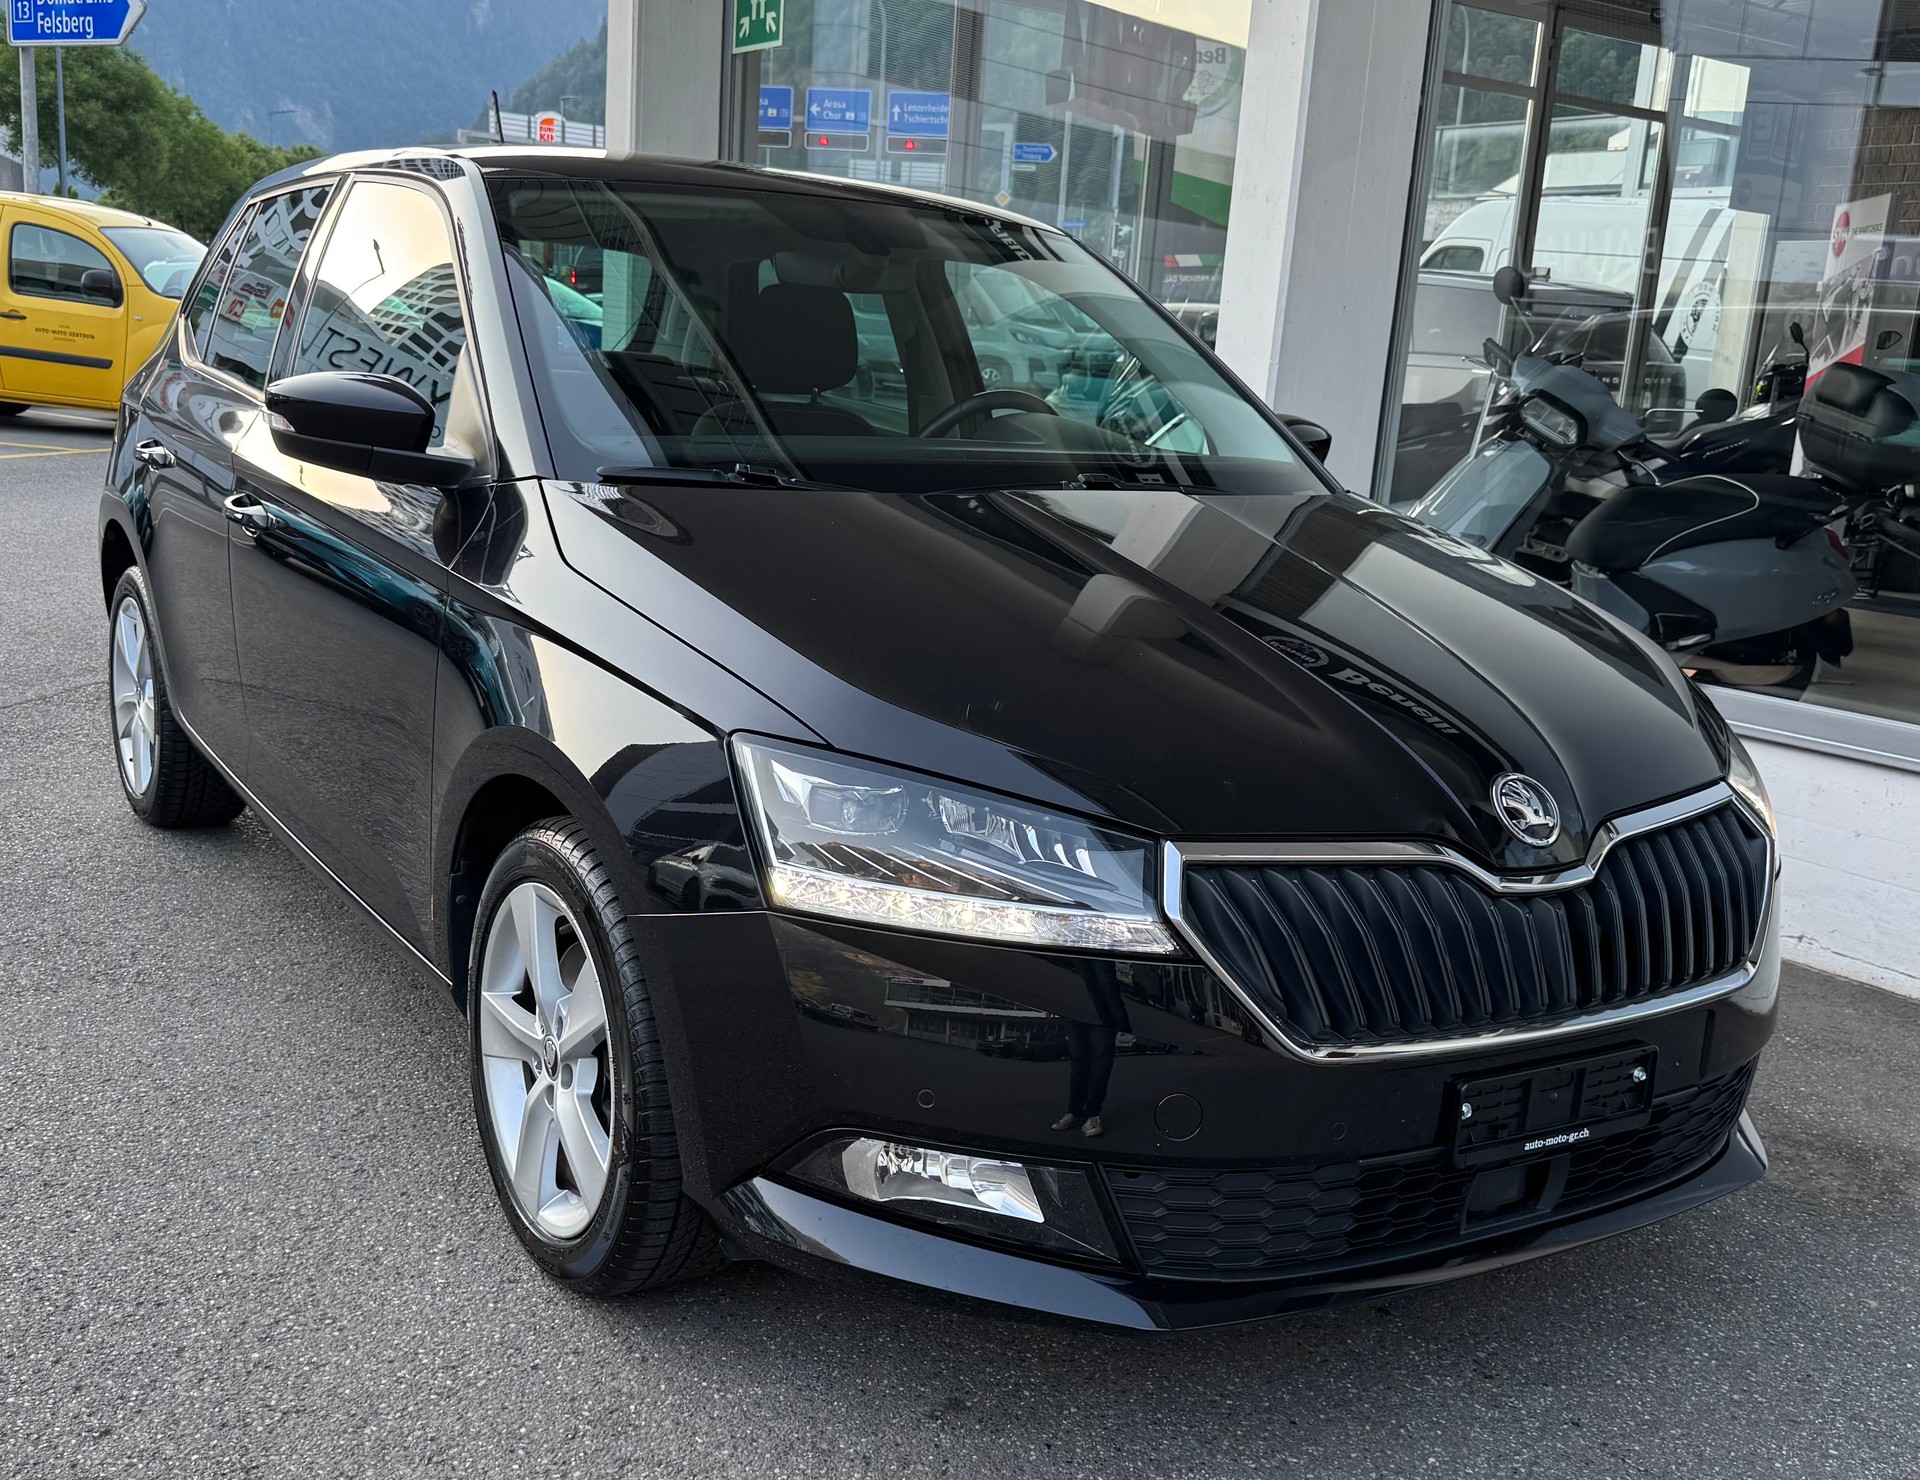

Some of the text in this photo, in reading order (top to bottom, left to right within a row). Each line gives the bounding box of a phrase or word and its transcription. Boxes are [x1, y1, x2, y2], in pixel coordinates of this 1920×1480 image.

[16, 1, 30, 19] 13
[37, 10, 94, 39] Felsberg
[823, 98, 847, 109] Arosa
[822, 110, 842, 120] Chur
[35, 326, 50, 335] AUTO
[51, 328, 68, 337] MOTO
[1644, 376, 1672, 385] OVER
[1524, 1127, 1590, 1151] auto-moto-gr.ch
